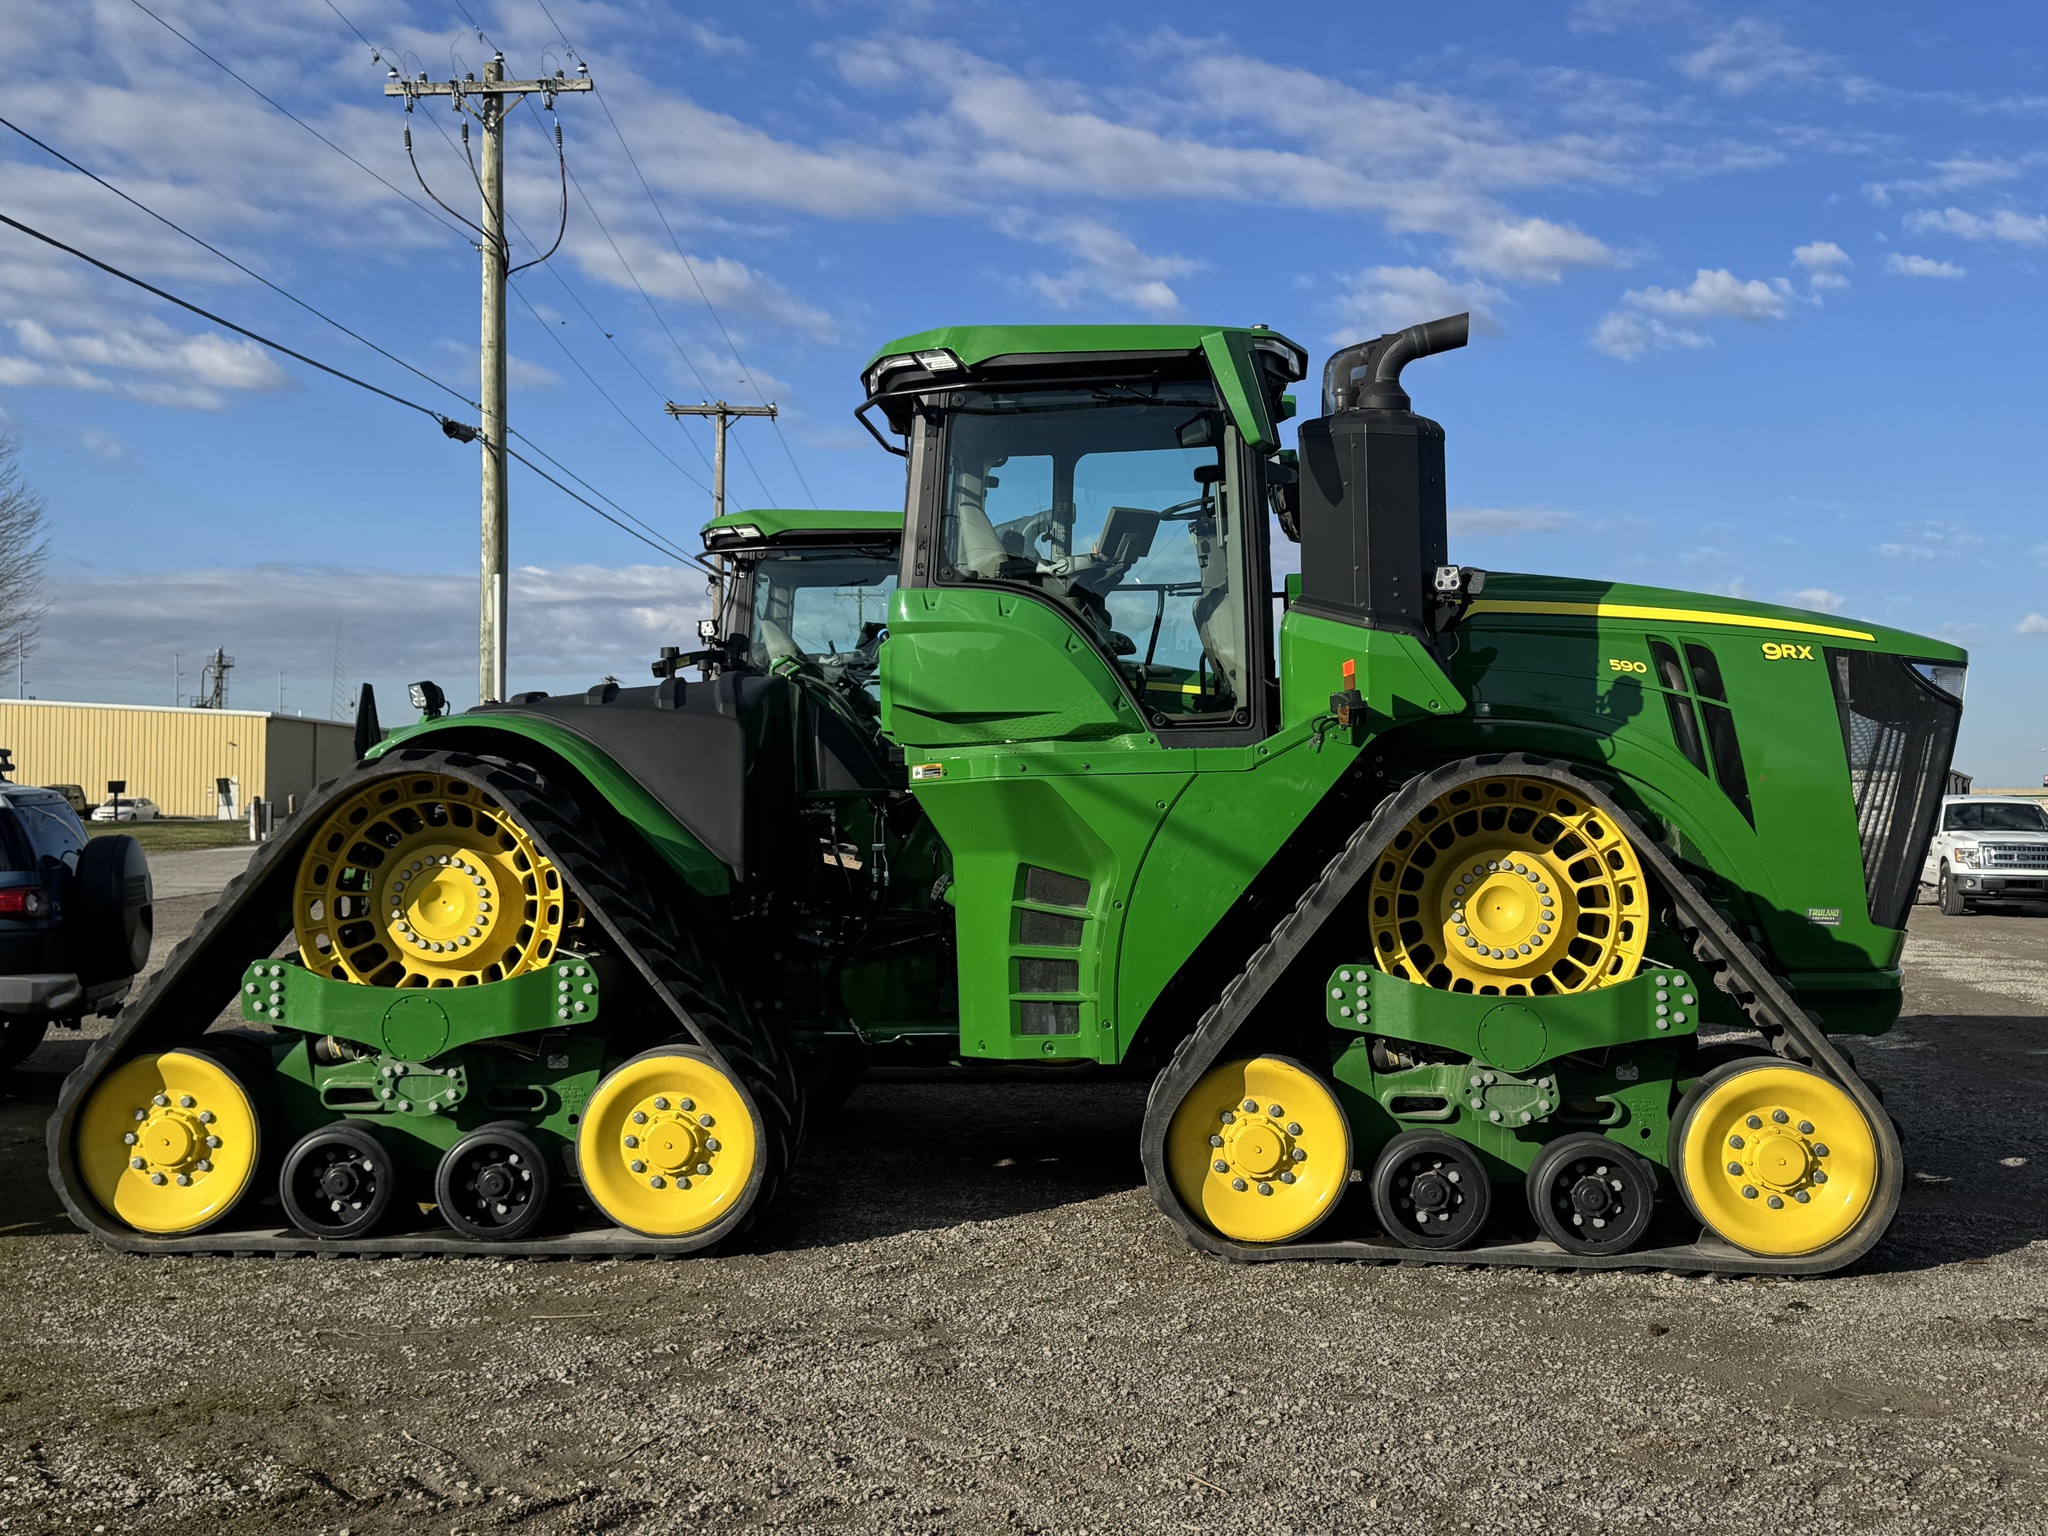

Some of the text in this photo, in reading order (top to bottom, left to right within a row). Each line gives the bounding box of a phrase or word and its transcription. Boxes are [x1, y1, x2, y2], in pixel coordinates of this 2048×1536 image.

[1761, 642, 1815, 661] 9RX
[1608, 659, 1648, 674] 590
[1808, 908, 1839, 916] TRULAND
